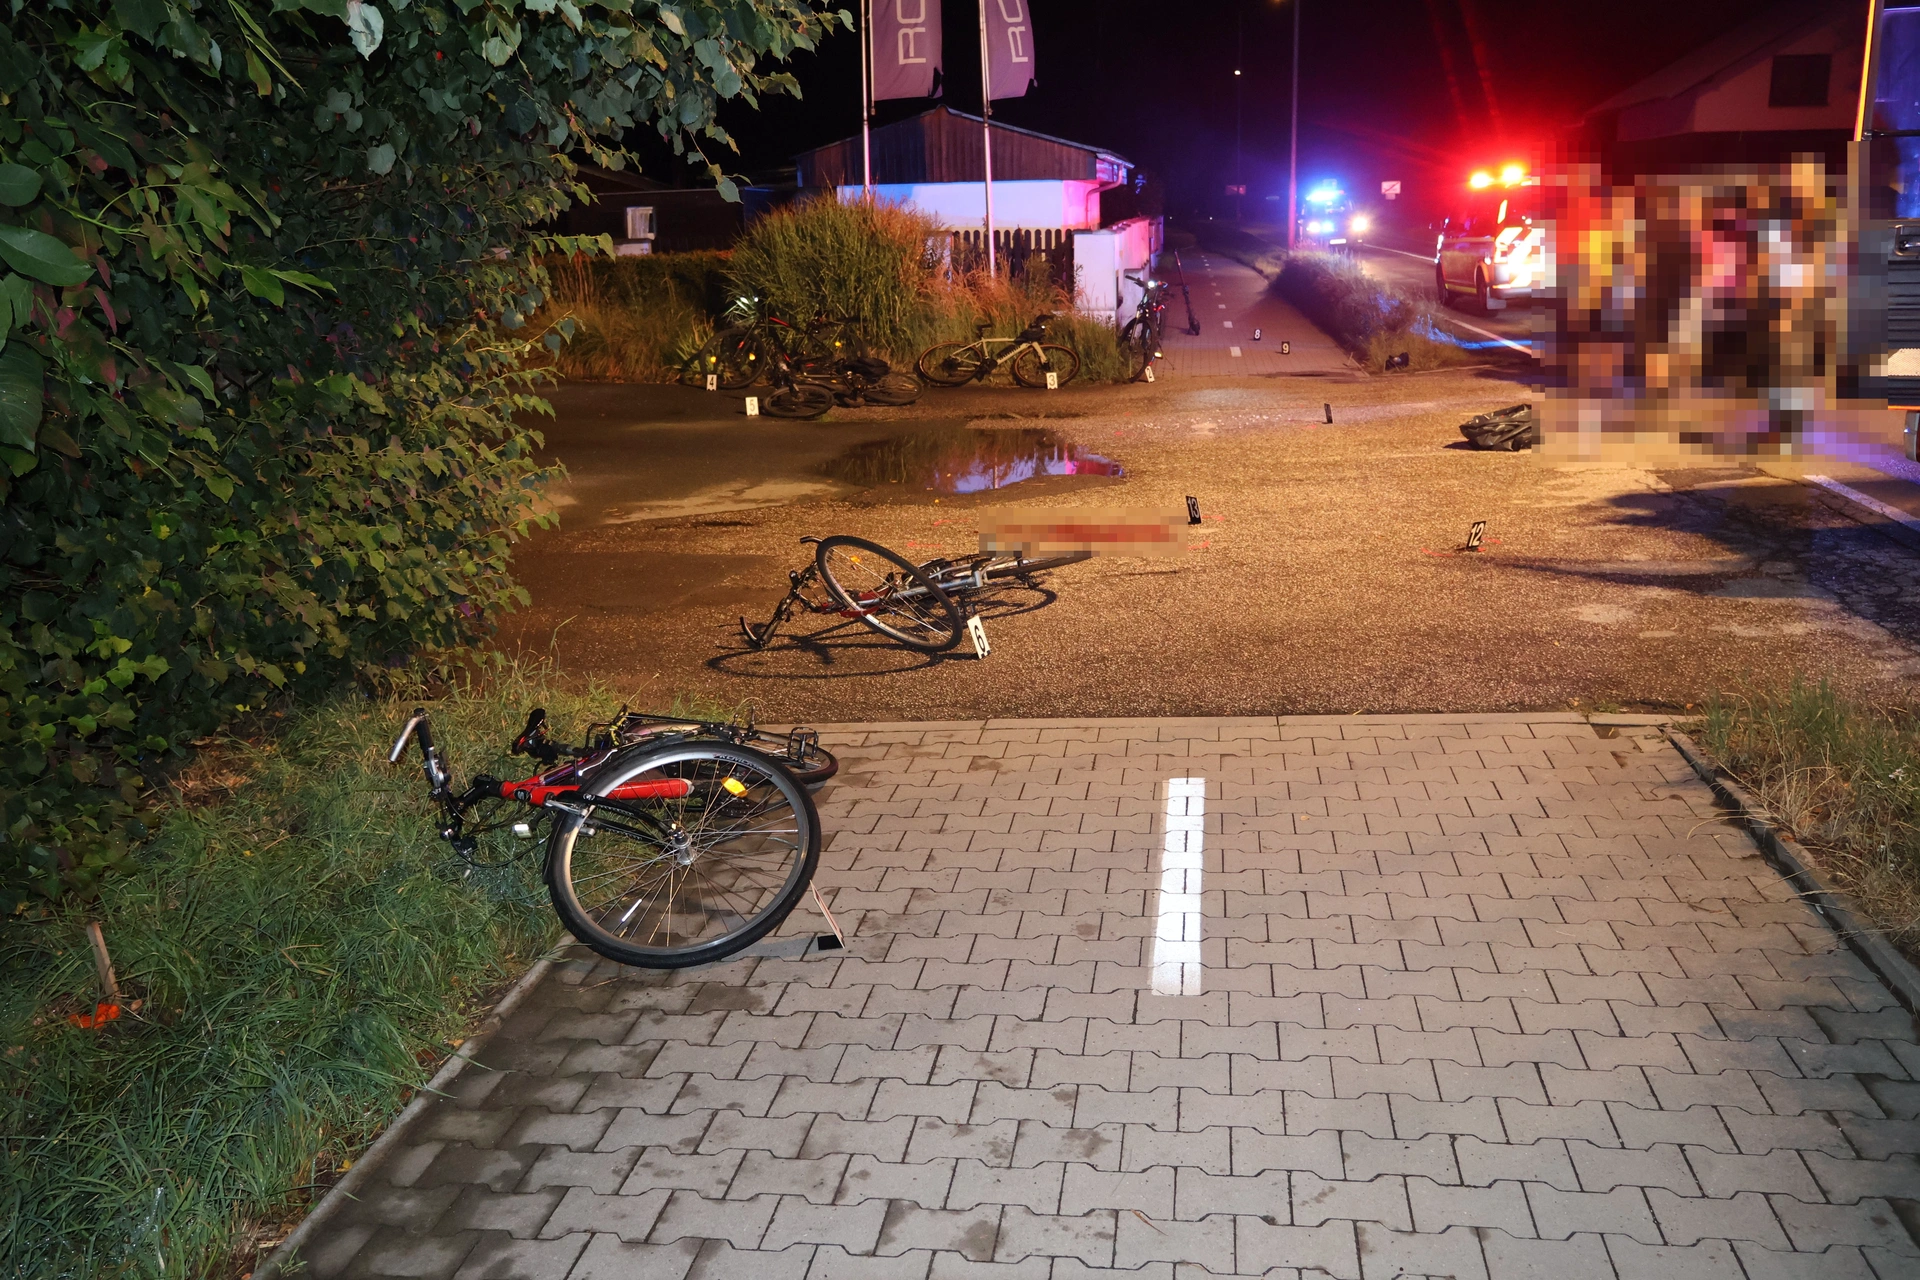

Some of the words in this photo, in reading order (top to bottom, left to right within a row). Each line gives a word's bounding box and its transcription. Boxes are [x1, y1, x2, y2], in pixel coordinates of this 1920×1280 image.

[1254, 329, 1260, 339] 8
[1282, 343, 1288, 353] 9
[709, 377, 714, 388] 4
[1048, 374, 1056, 387] 3
[749, 399, 756, 412] 5
[1188, 497, 1200, 519] 13
[1468, 522, 1485, 547] 12
[974, 625, 986, 652] 6
